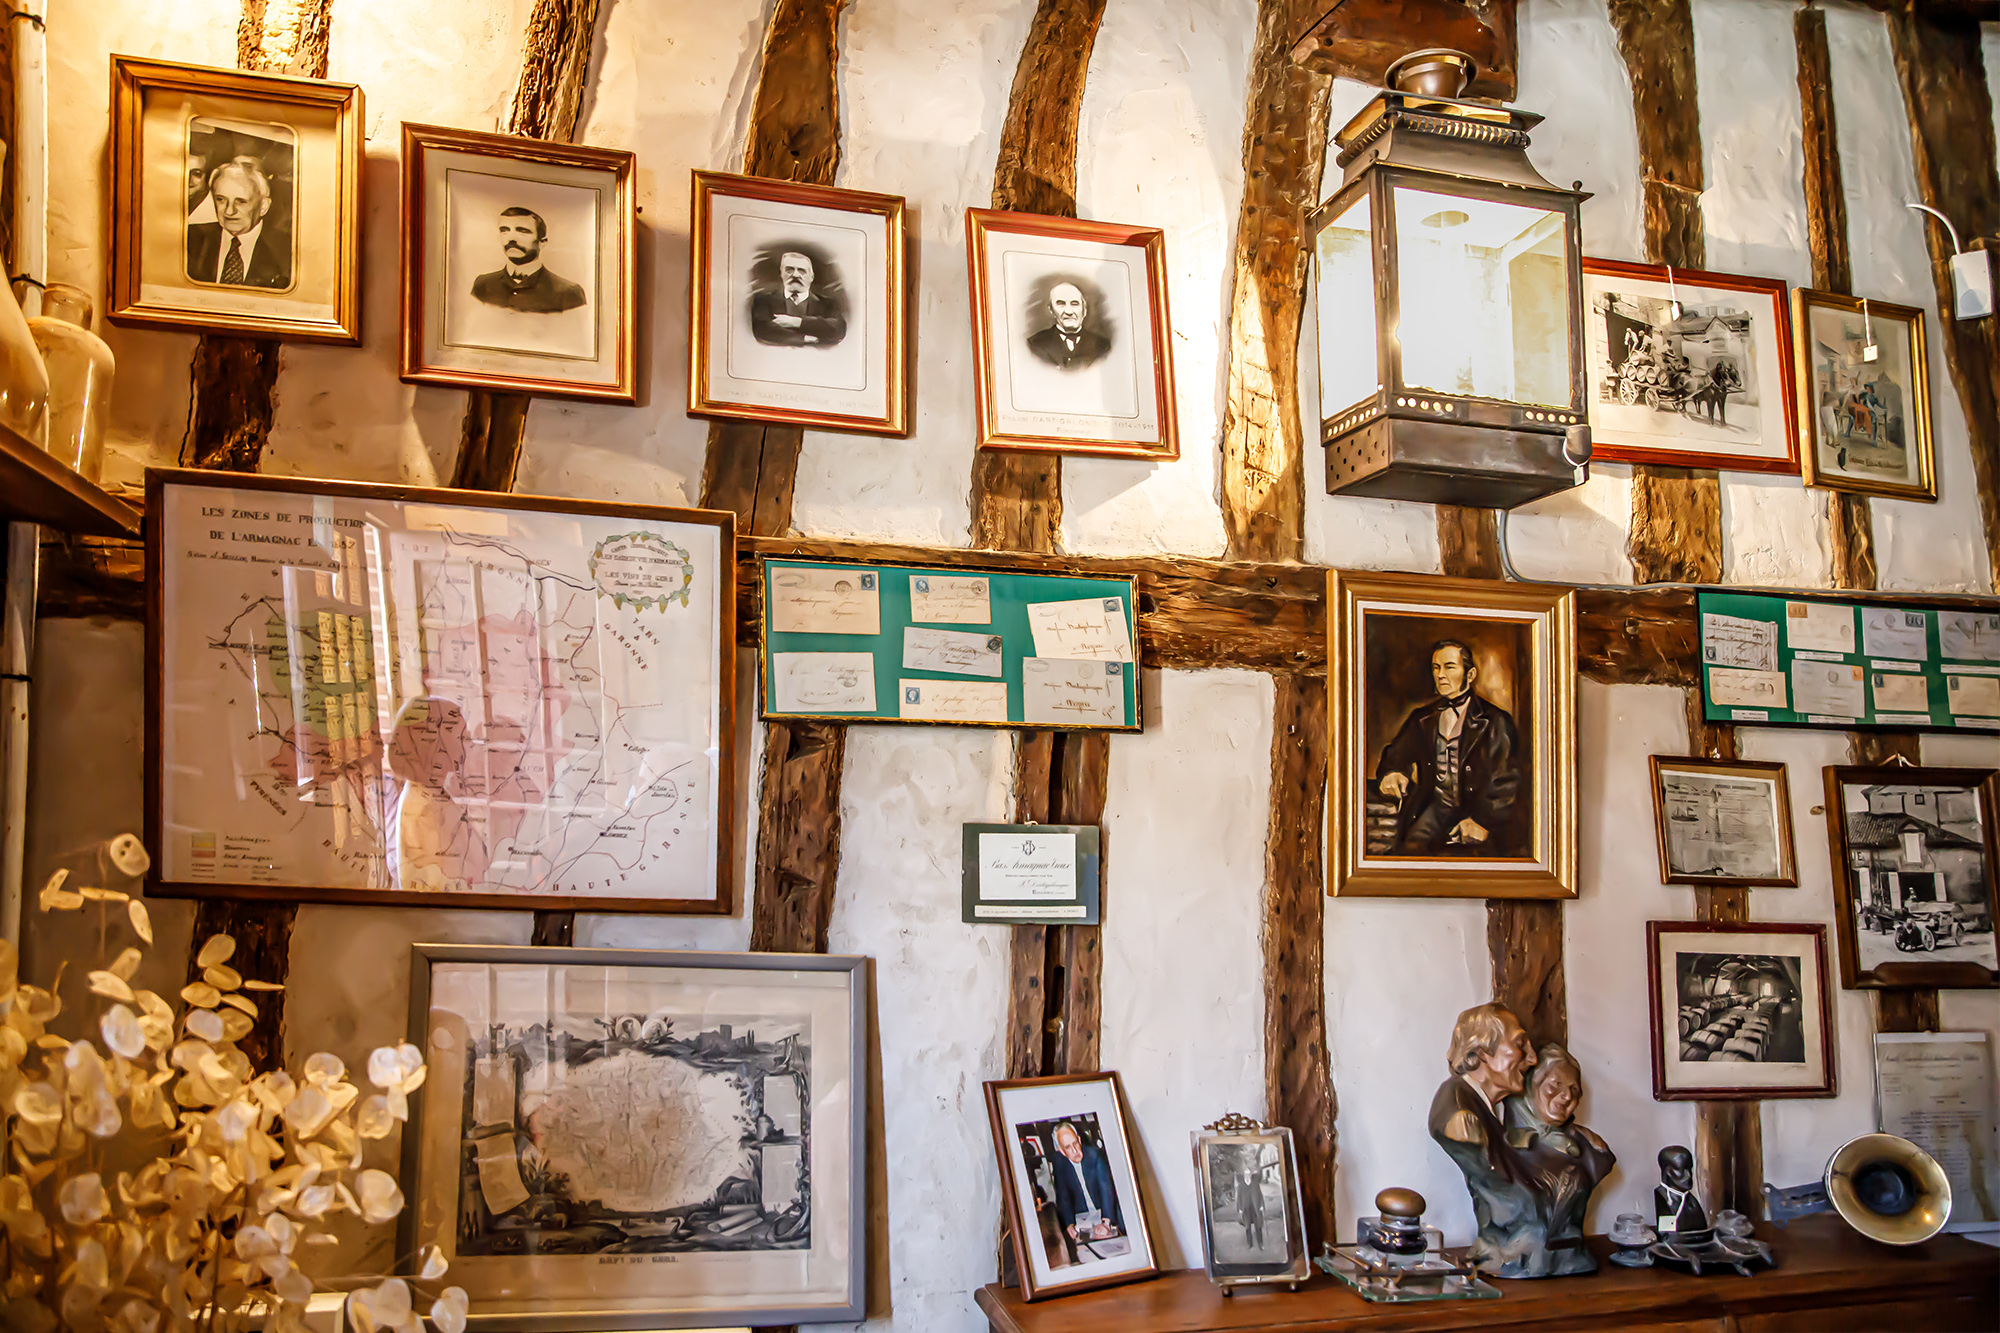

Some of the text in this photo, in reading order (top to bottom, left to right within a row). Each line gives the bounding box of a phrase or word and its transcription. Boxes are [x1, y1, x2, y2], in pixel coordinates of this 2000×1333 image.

[202, 506, 366, 529] LES ZONES DE PRODUCTION
[210, 530, 225, 541] DE
[231, 532, 301, 547] L'ARMAGNAC
